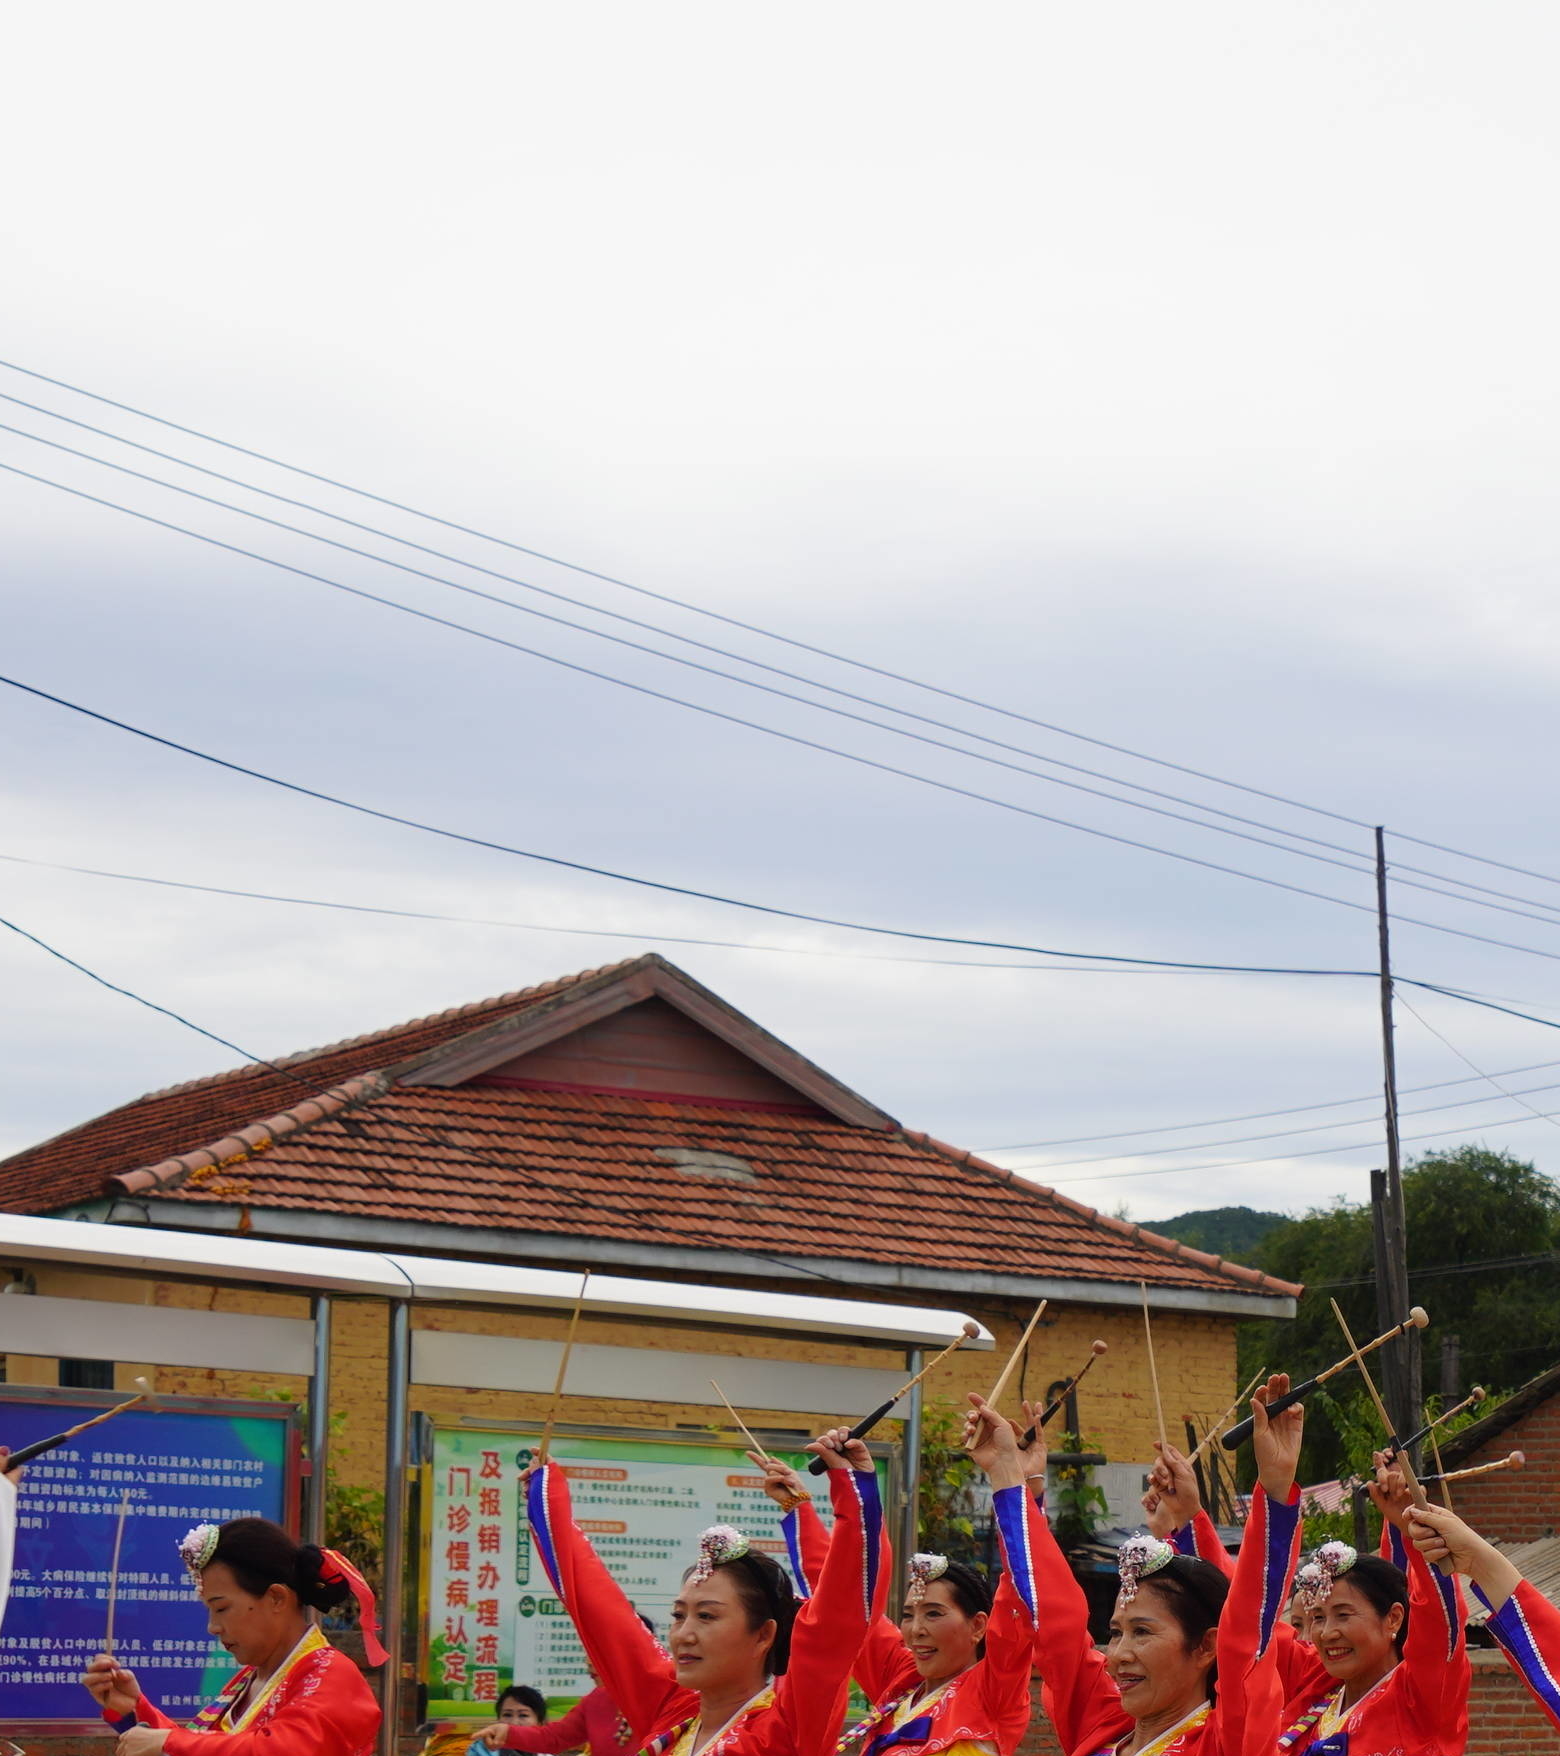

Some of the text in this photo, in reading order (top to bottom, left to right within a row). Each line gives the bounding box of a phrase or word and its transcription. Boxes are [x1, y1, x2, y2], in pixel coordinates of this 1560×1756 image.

[443, 1465, 472, 1684] 门诊慢病认定
[473, 1450, 503, 1702] 及报销办理流程
